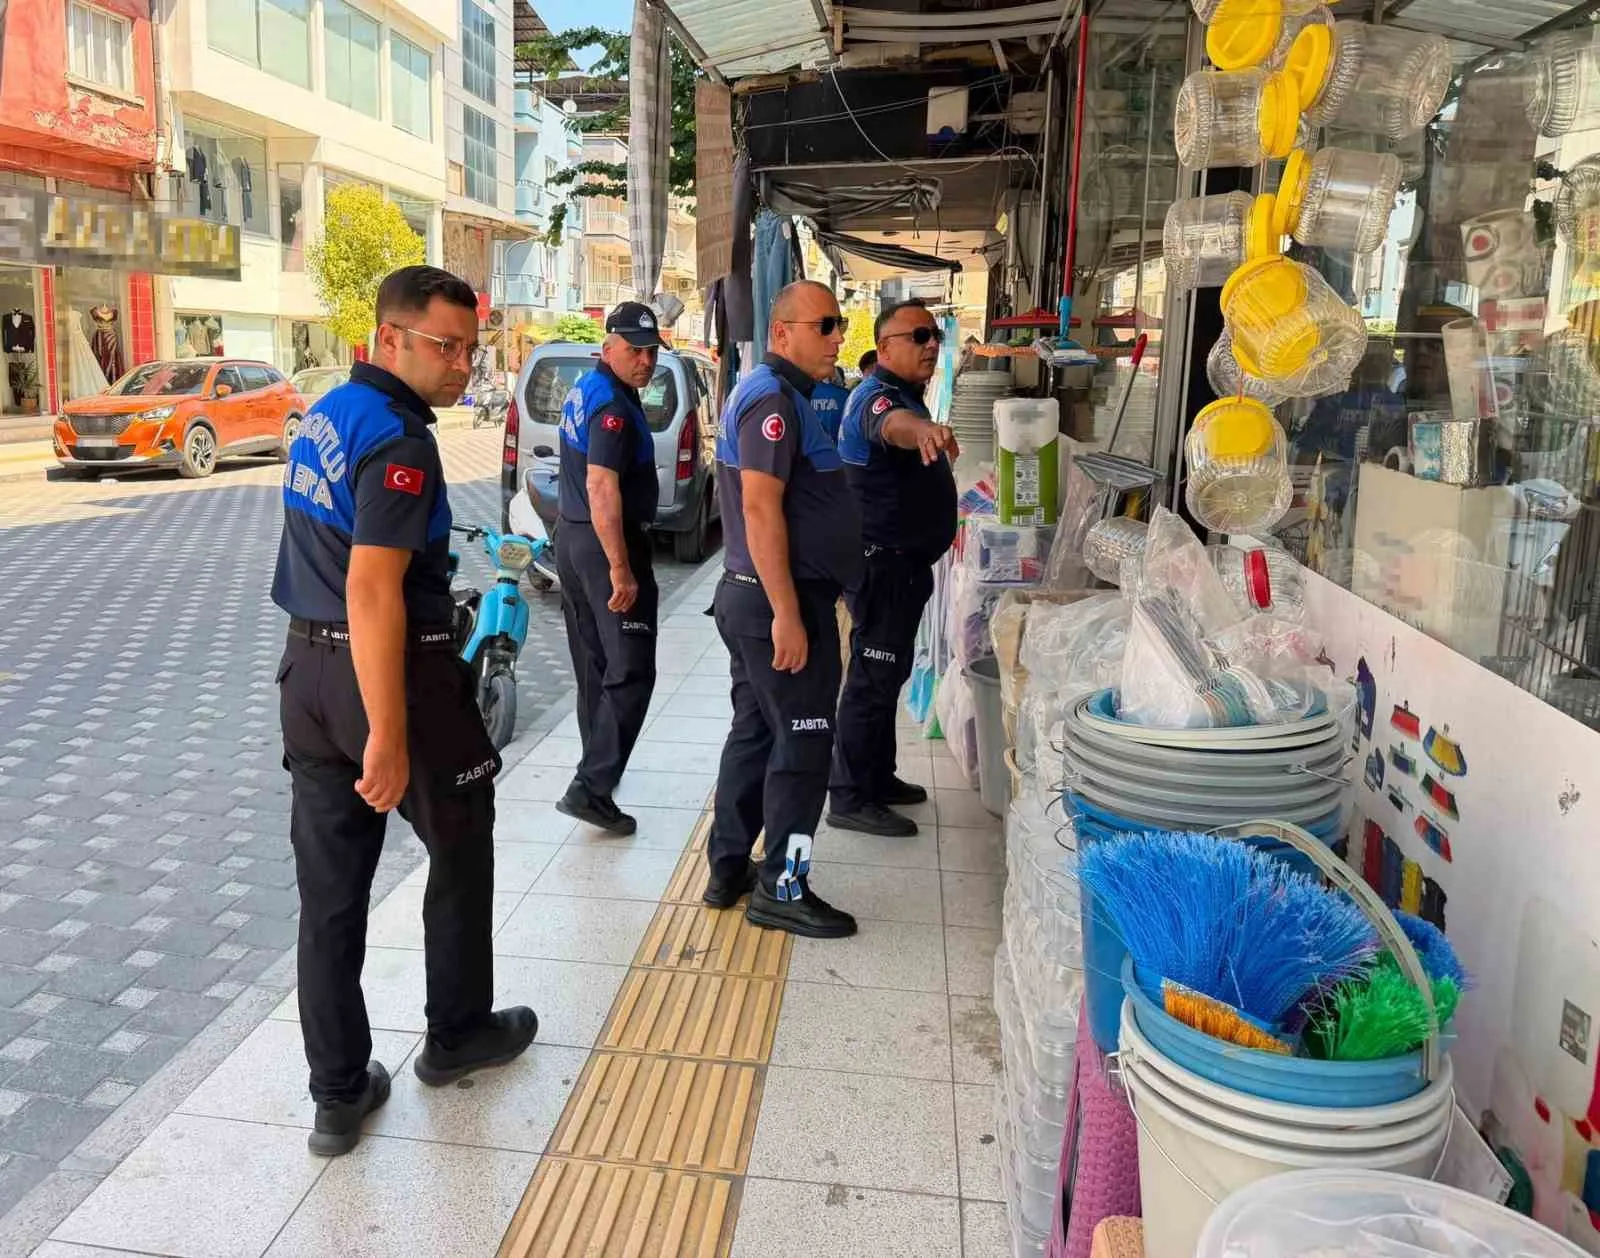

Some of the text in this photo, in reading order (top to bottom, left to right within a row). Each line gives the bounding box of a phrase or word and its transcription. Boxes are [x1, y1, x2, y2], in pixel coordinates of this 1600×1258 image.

[863, 647, 896, 664] ZABITA
[791, 718, 829, 731] ZABITA
[455, 758, 496, 786] ZABITA
